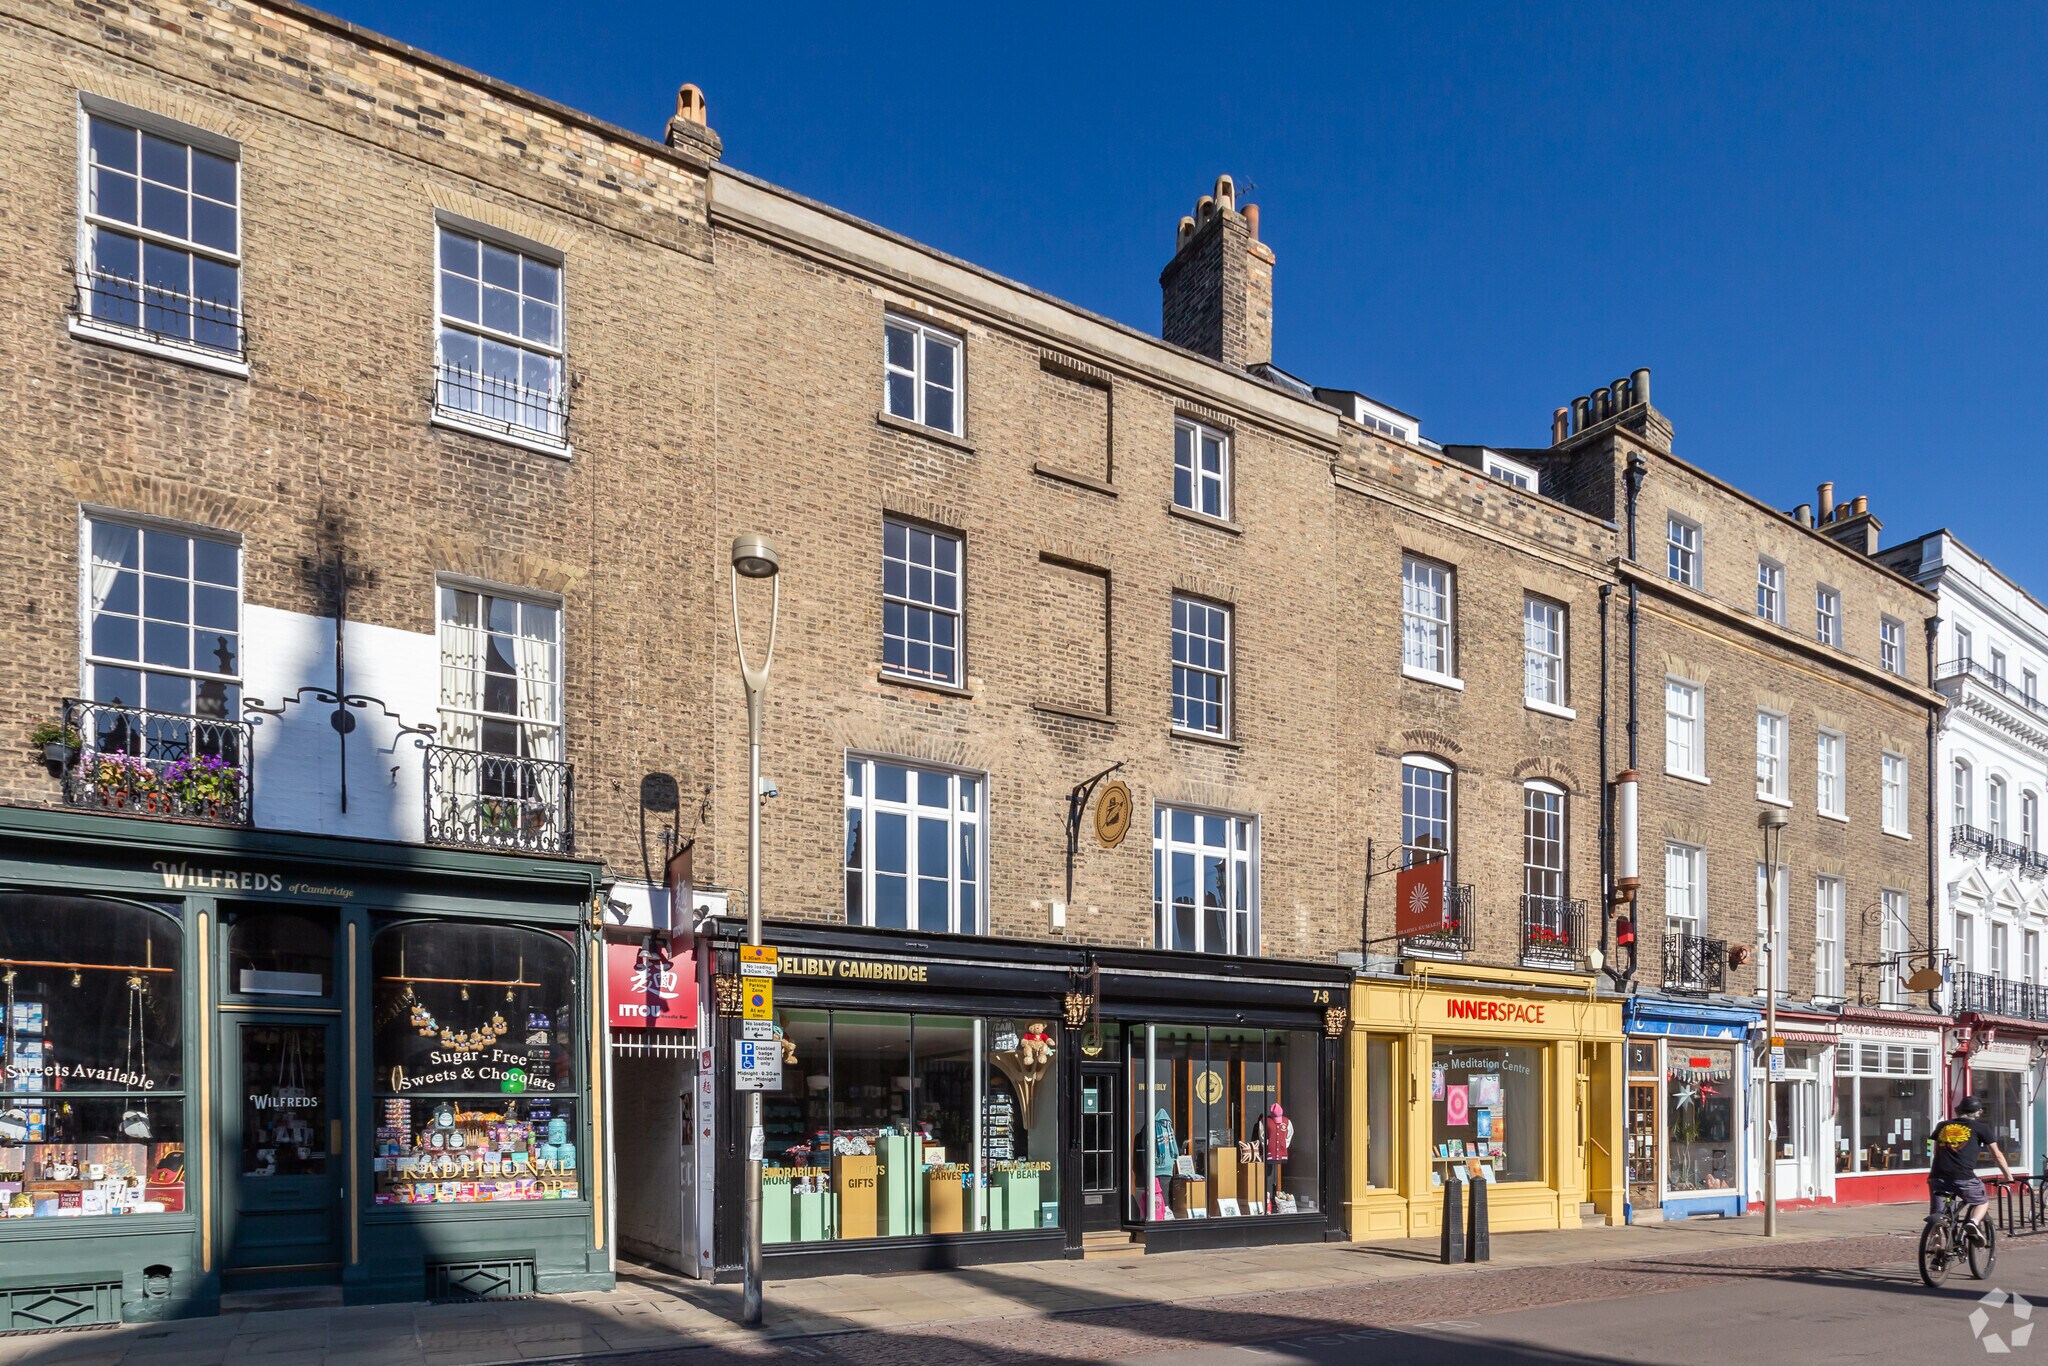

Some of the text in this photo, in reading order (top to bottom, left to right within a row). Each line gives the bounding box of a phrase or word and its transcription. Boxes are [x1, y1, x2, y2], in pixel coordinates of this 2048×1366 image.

[288, 883, 300, 895] of
[300, 884, 354, 899] Cambridge
[838, 960, 928, 982] CAMBRIDGE
[1312, 989, 1329, 1004] 7-8
[618, 1003, 661, 1017] ITTOU
[1447, 998, 1545, 1024] INNERSPACE
[1906, 1029, 1928, 1040] KETTLE
[744, 1043, 752, 1054] P
[1636, 1049, 1643, 1062] 5
[430, 1050, 478, 1065] Sugar
[492, 1049, 528, 1066] Free
[1451, 1057, 1499, 1070] Meditation
[1502, 1059, 1530, 1075] Centre
[6, 1063, 155, 1090] Sweets Available
[401, 1066, 556, 1091] Sweets & Chocolate
[1246, 1084, 1276, 1092] CAMBRDGE
[386, 1159, 573, 1180] TRADITIONAL
[1024, 1160, 1052, 1171] BEARS
[495, 1179, 564, 1197] SHOP
[848, 1178, 874, 1189] GIFTS
